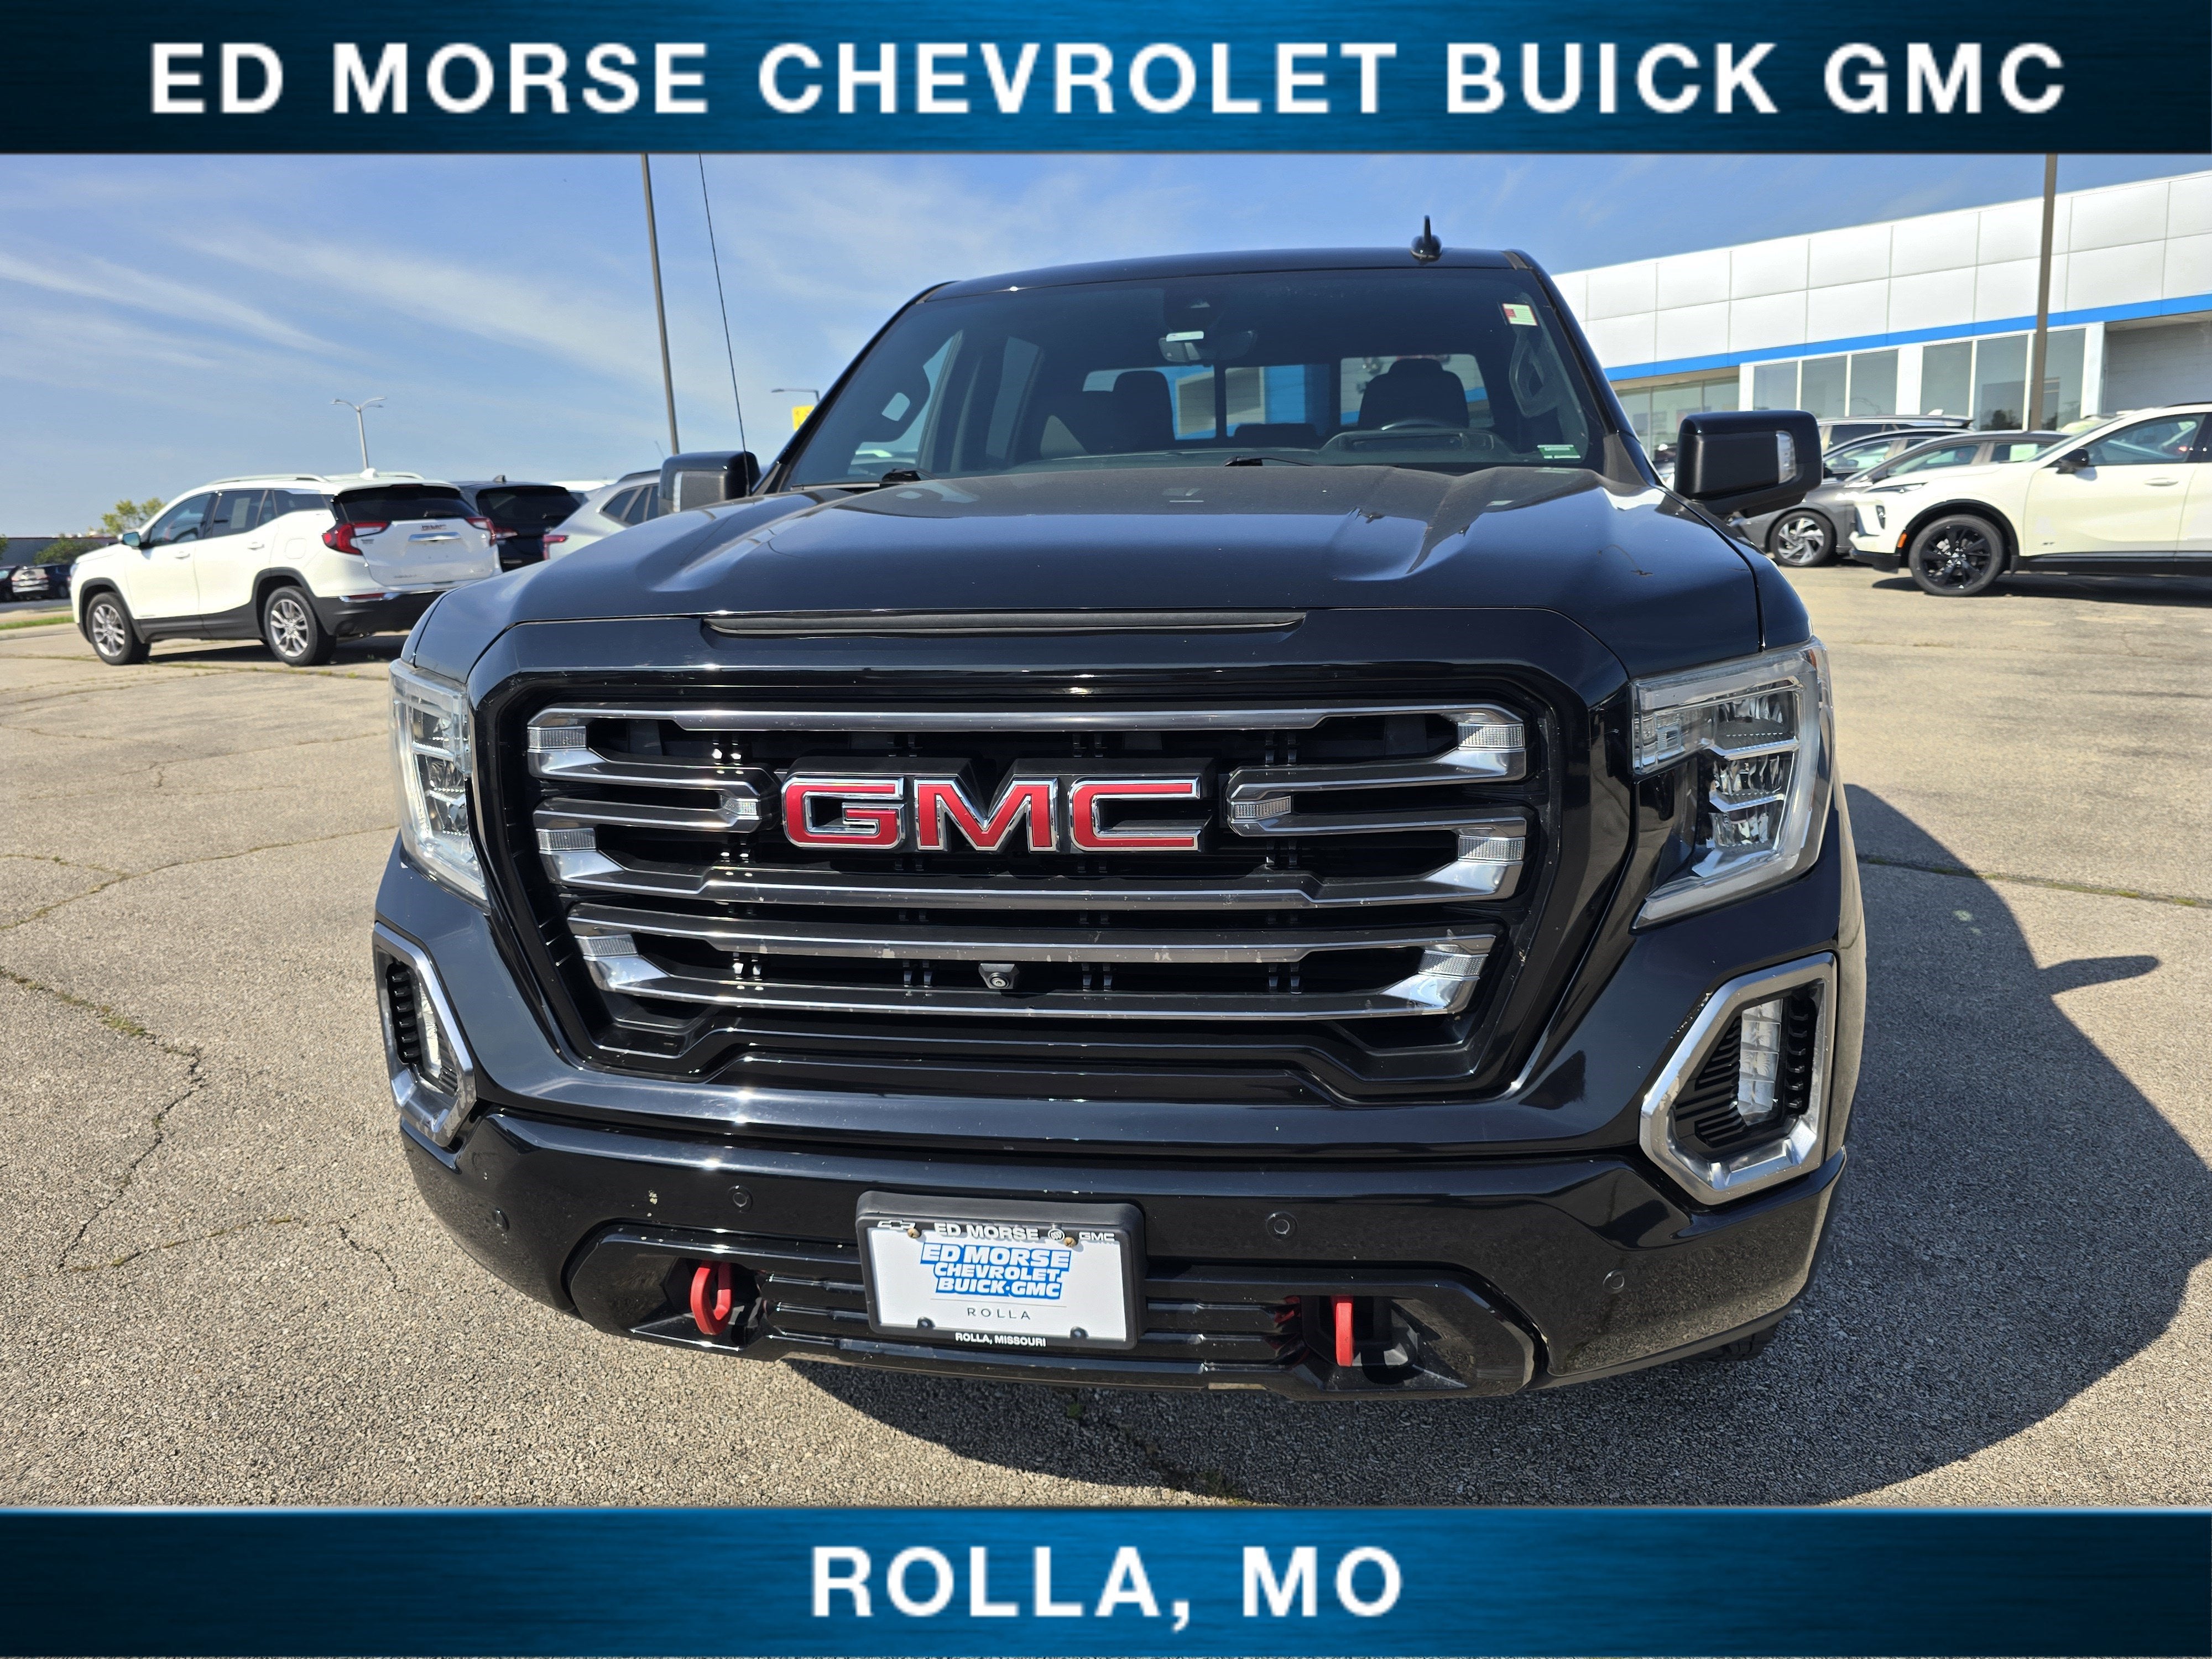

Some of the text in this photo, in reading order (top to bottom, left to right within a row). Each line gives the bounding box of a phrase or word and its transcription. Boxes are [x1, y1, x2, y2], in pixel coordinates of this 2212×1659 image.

[781, 776, 1203, 852] GMC
[934, 1223, 1040, 1241] ED MORSE
[1079, 1232, 1115, 1241] GMC
[922, 1244, 1071, 1268] ED MORSE
[967, 1307, 1031, 1320] ROLLA
[955, 1332, 1046, 1347] ROLLA, MISSOURI
